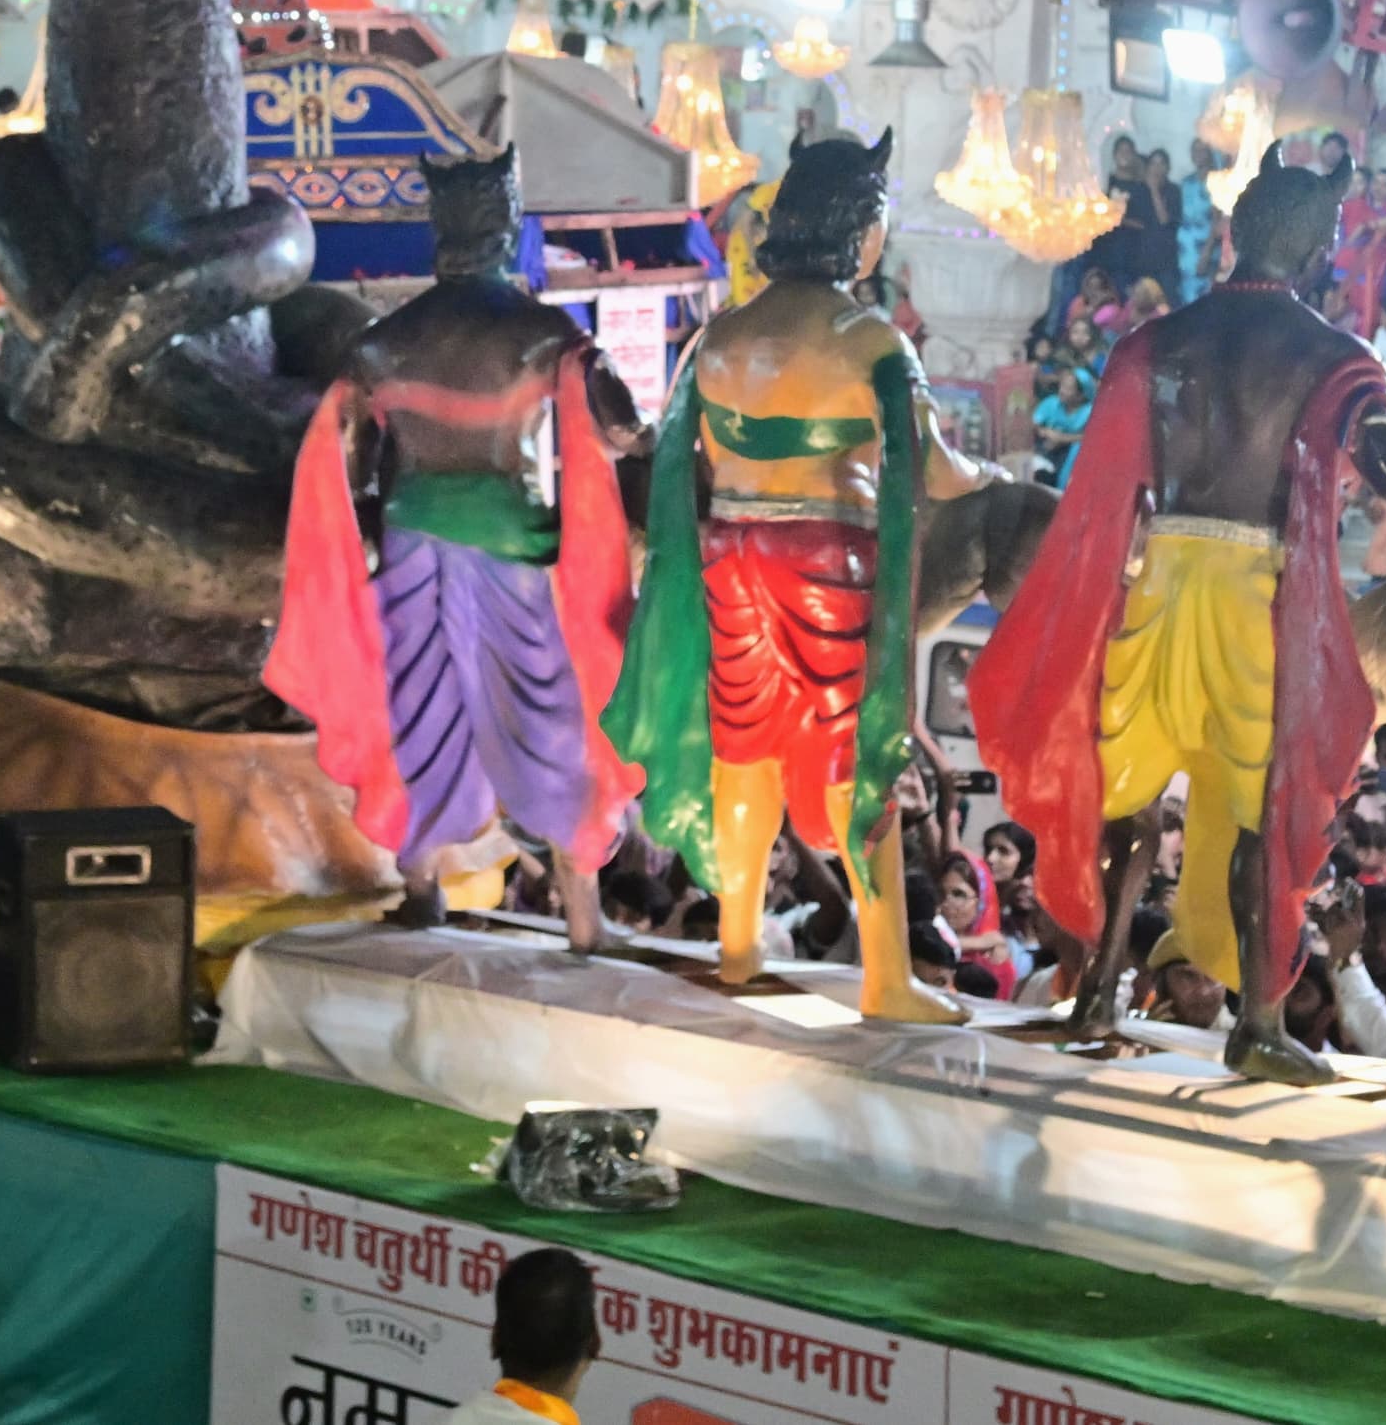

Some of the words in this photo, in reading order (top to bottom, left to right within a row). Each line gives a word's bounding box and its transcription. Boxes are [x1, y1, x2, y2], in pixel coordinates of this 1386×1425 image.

[248, 1190, 348, 1259] गणेश
[354, 1219, 454, 1293] चतुर्थी
[379, 1320, 427, 1356] YEARS
